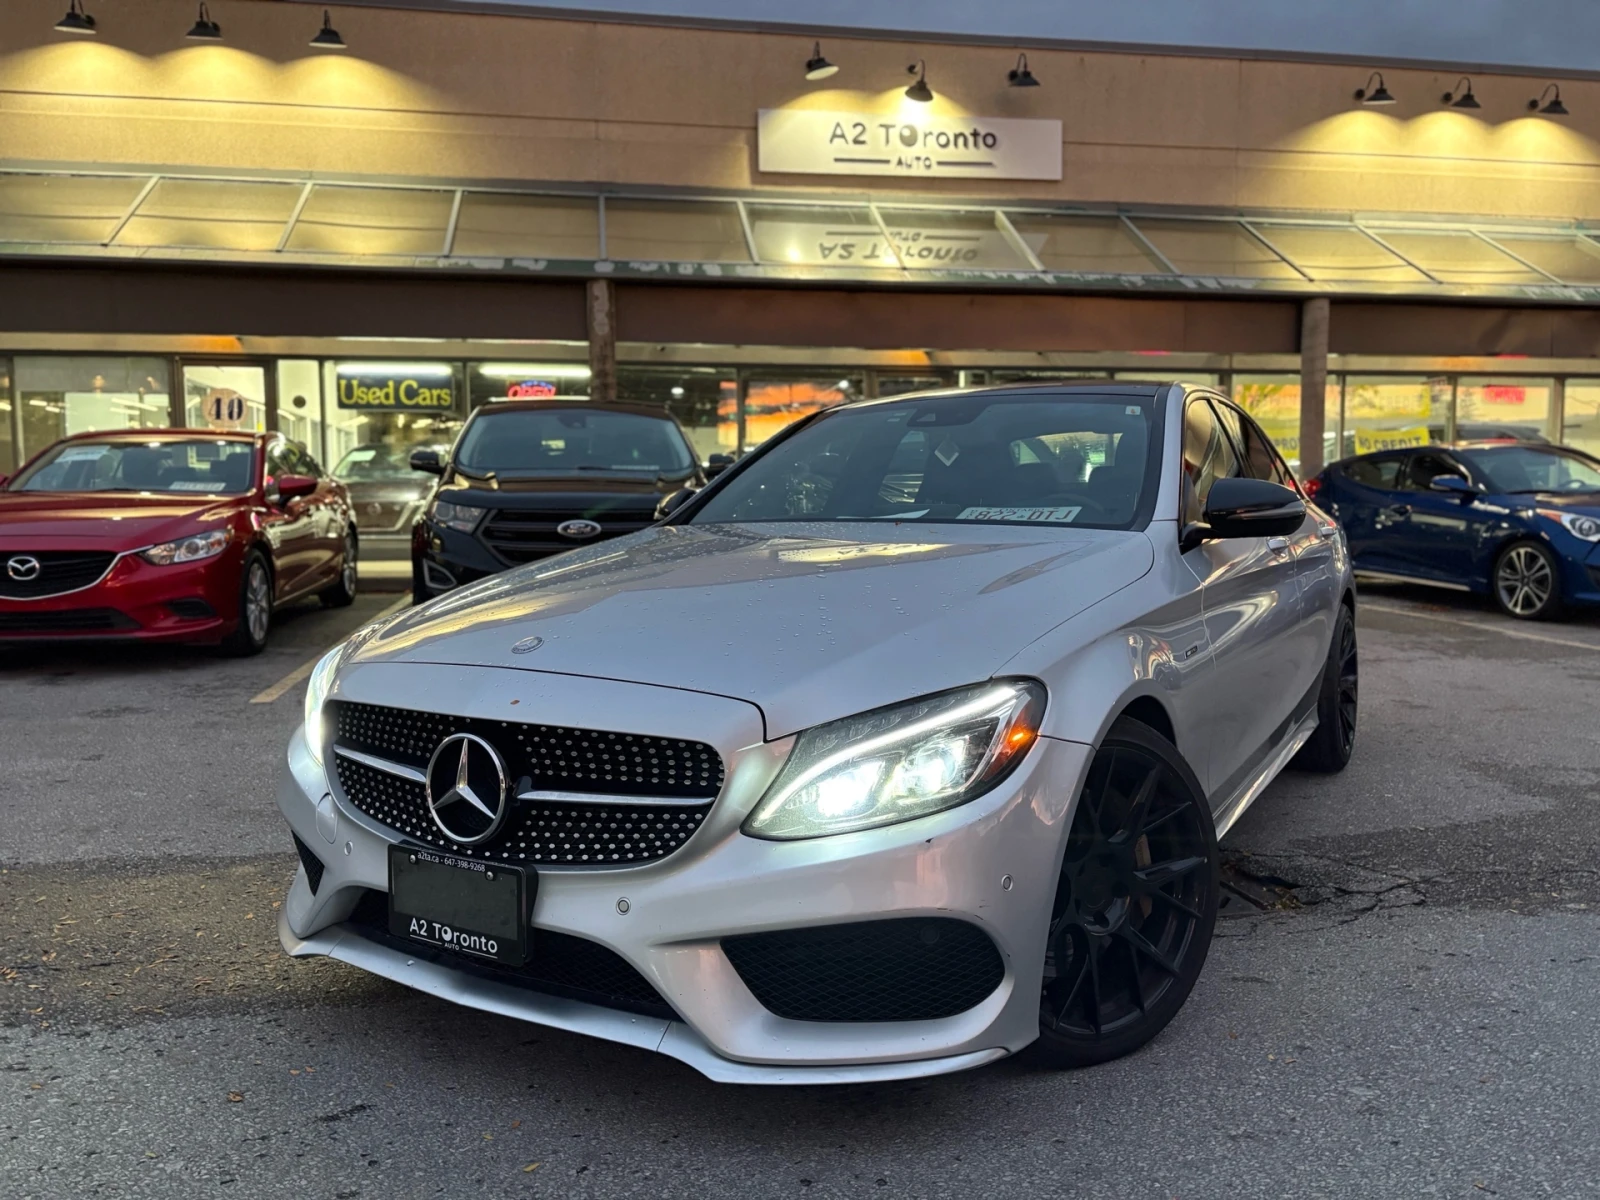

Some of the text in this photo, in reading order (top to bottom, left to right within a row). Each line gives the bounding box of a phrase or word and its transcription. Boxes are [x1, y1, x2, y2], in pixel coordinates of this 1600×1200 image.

[829, 121, 867, 145] A2
[896, 156, 932, 170] AUTO
[339, 379, 451, 406] Used Cars
[974, 510, 1017, 521] 822
[417, 851, 486, 872] a2ta.ca 647-398-9268
[409, 917, 428, 936] A2
[444, 942, 460, 951] AUTO
